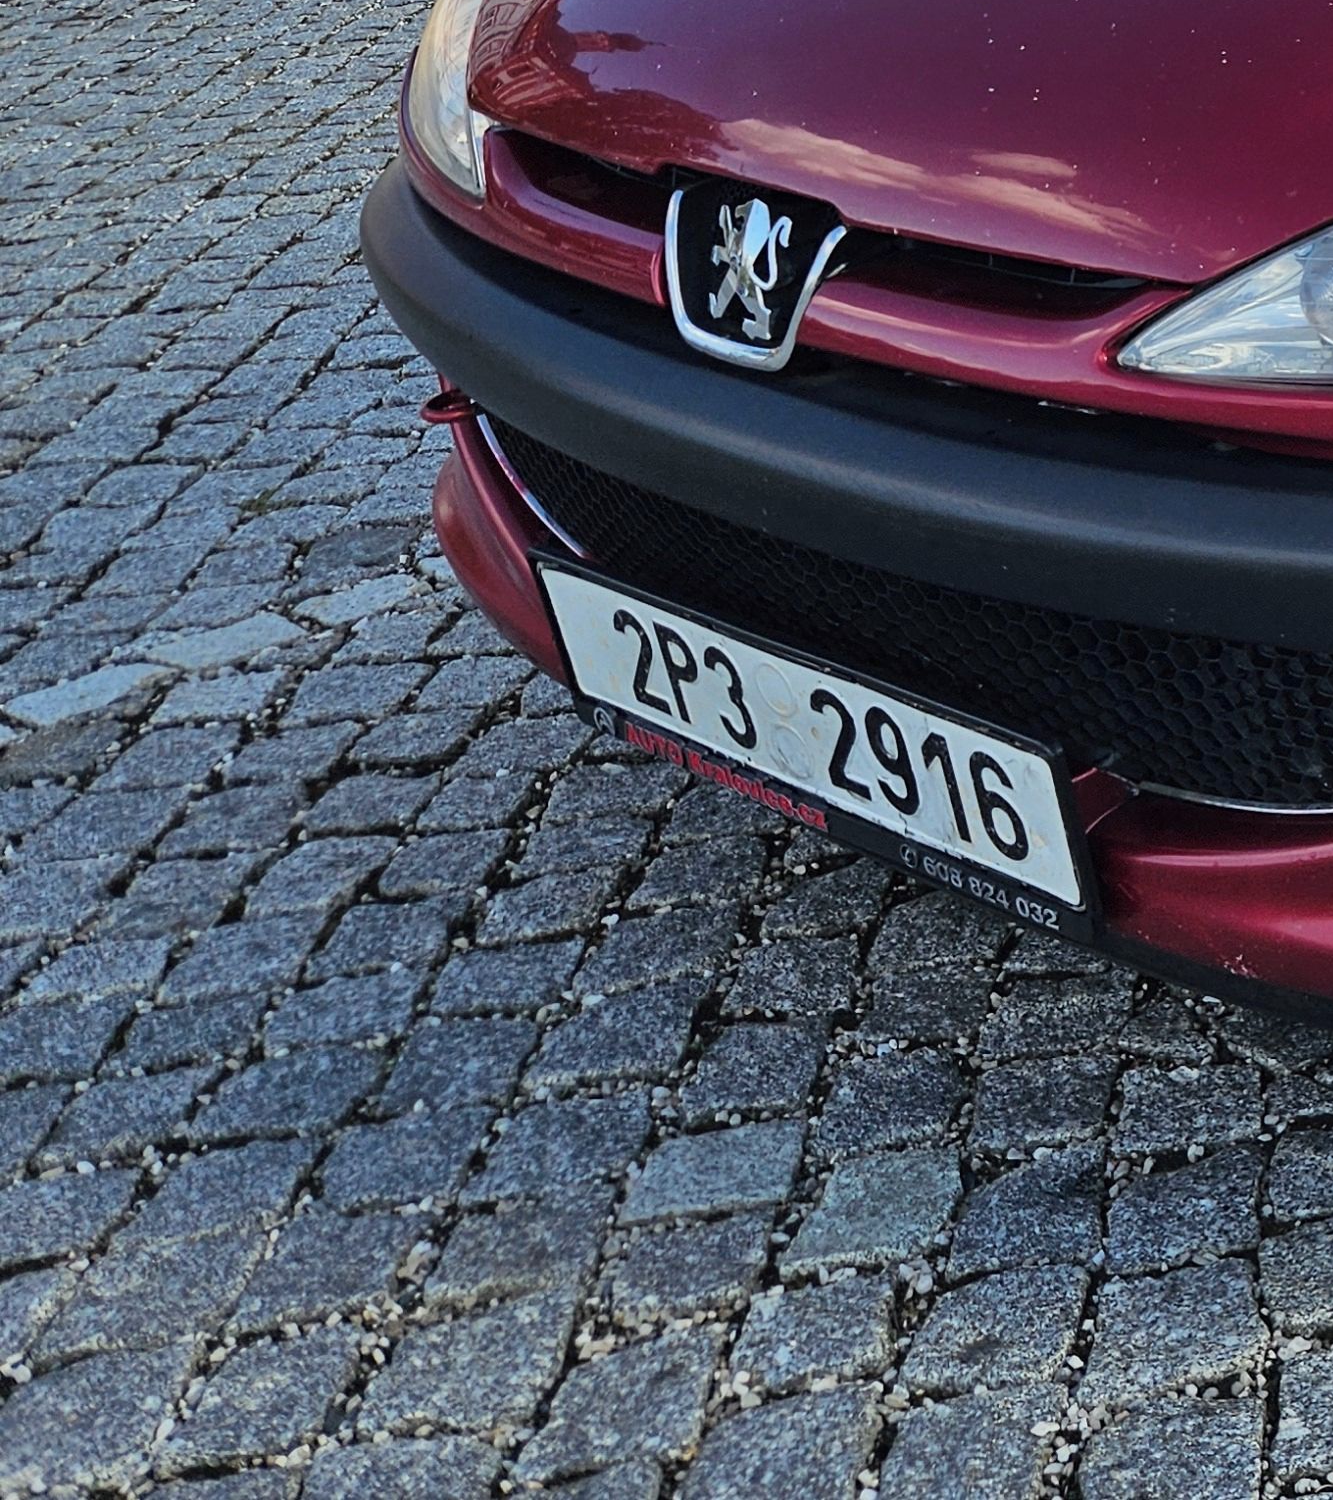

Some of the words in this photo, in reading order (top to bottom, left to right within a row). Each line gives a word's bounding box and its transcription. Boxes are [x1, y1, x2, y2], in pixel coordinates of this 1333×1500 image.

[613, 608, 757, 750] 2P3
[809, 688, 1030, 861] 2916
[625, 720, 684, 767] AUTO
[923, 856, 962, 888] 608
[968, 876, 1011, 910] 824
[1015, 896, 1060, 931] 032
